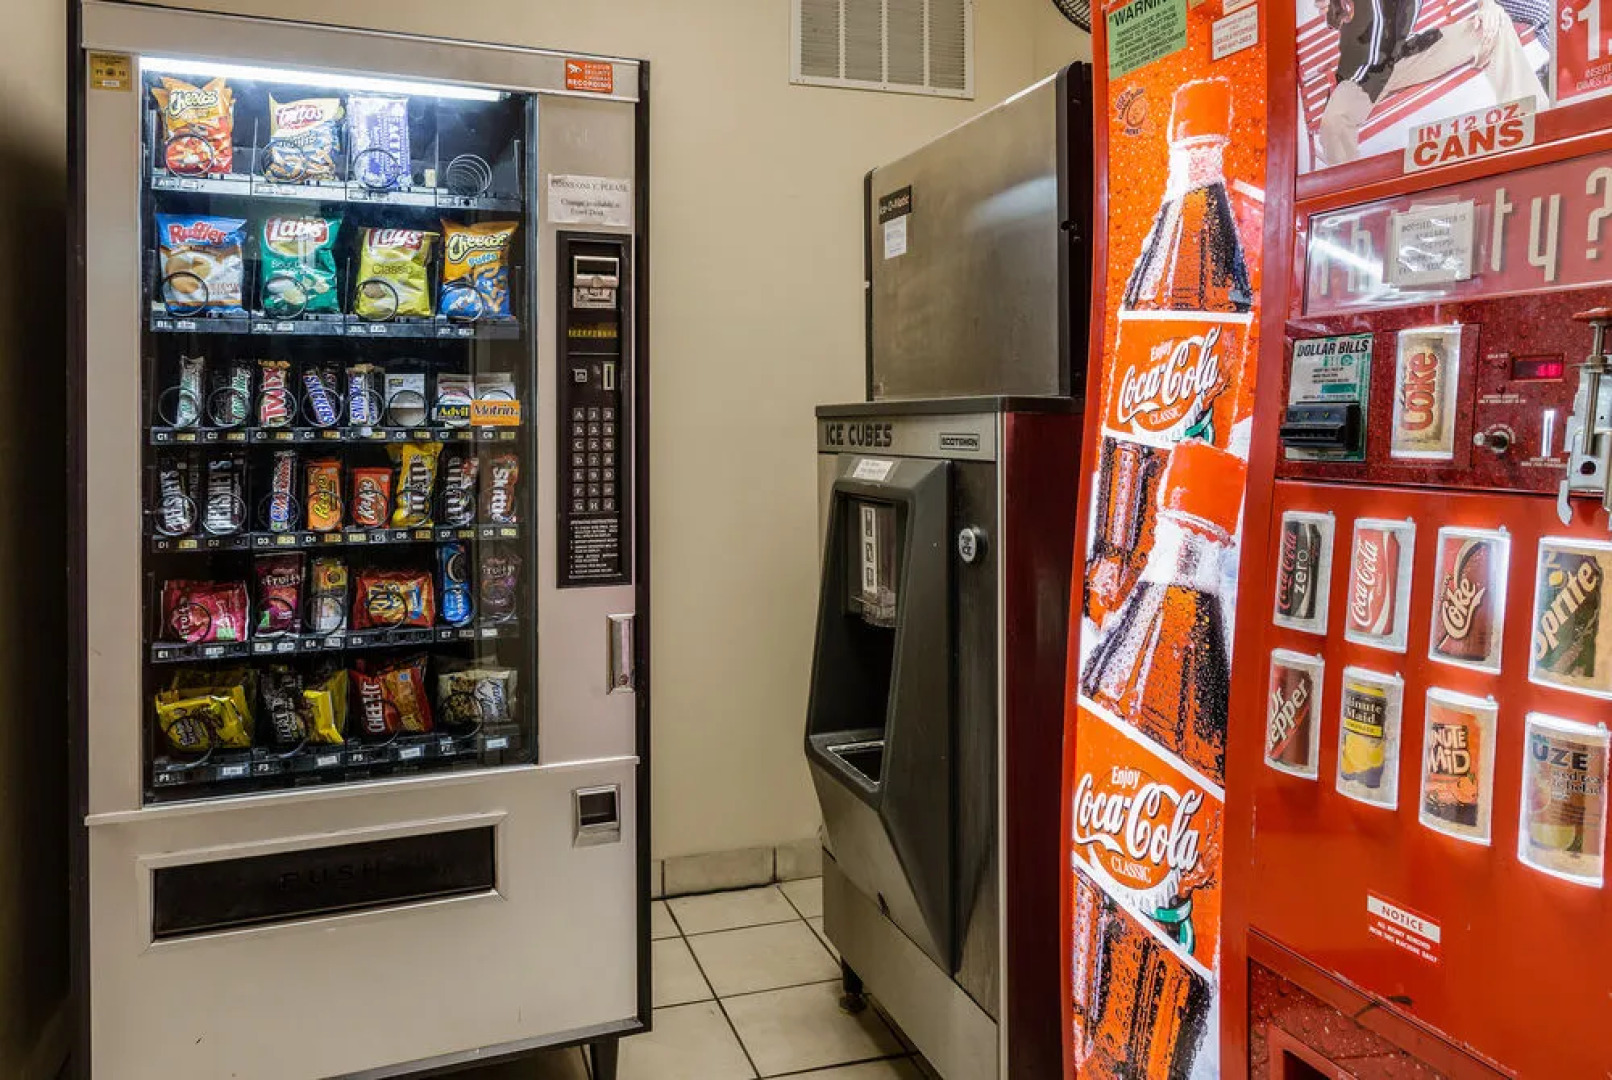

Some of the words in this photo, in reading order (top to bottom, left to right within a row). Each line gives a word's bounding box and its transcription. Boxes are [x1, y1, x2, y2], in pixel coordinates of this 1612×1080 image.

[567, 79, 611, 88] RECORDING
[1417, 124, 1442, 143] IN
[1451, 116, 1477, 133] 12
[1485, 102, 1526, 125] OZ.
[1413, 119, 1524, 167] CANS
[372, 263, 413, 275] Classic
[1150, 339, 1174, 362] Enjoy
[1297, 342, 1337, 357] DOLLAR
[1338, 339, 1369, 354] BILLS
[1116, 323, 1222, 425] Coca-Cola
[303, 375, 336, 424] SNICKERS
[1401, 352, 1440, 431] Coke
[438, 405, 470, 418] Advil
[473, 404, 517, 417] Motrin
[825, 424, 844, 446] ICE
[849, 423, 893, 448] CUBES
[1294, 548, 1309, 594] zero
[1442, 577, 1486, 640] Coke
[1270, 679, 1309, 750] epper
[1111, 765, 1141, 789] Enjoy
[1072, 772, 1204, 873] Coca-Cola
[1111, 855, 1152, 884] CLASSIC
[1382, 905, 1424, 932] NOTICE
